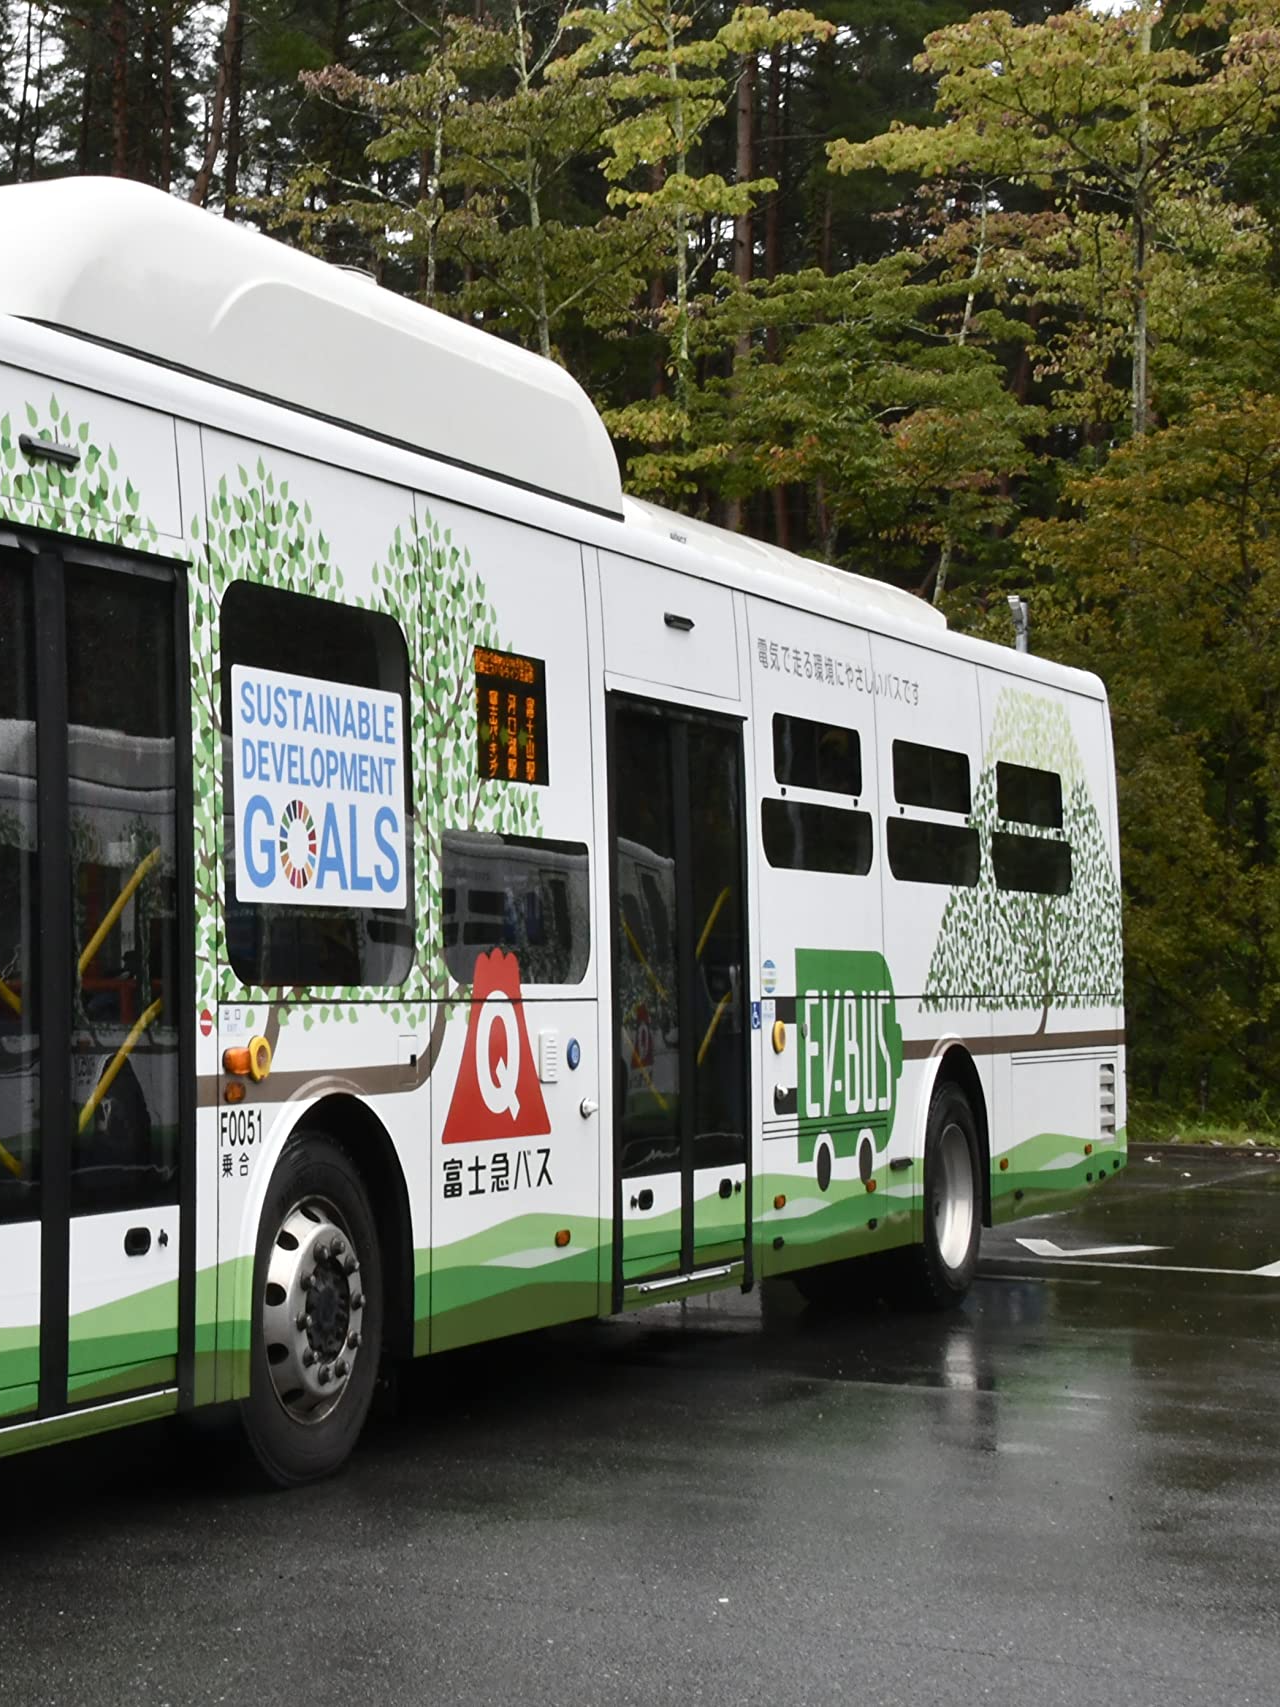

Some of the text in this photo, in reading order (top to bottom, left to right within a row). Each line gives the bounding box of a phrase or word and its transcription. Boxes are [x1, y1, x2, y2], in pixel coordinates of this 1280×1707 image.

[757, 638, 920, 706] 電気で走る環境にやさしいバスです
[240, 680, 396, 745] SUSTAINABLE
[241, 737, 396, 796] DEVELOPMENT
[242, 794, 400, 893] GOALS
[476, 990, 521, 1121] Q
[220, 1109, 262, 1147] F0051
[222, 1152, 250, 1178] 乗合
[443, 1148, 553, 1199] 富士急バス
